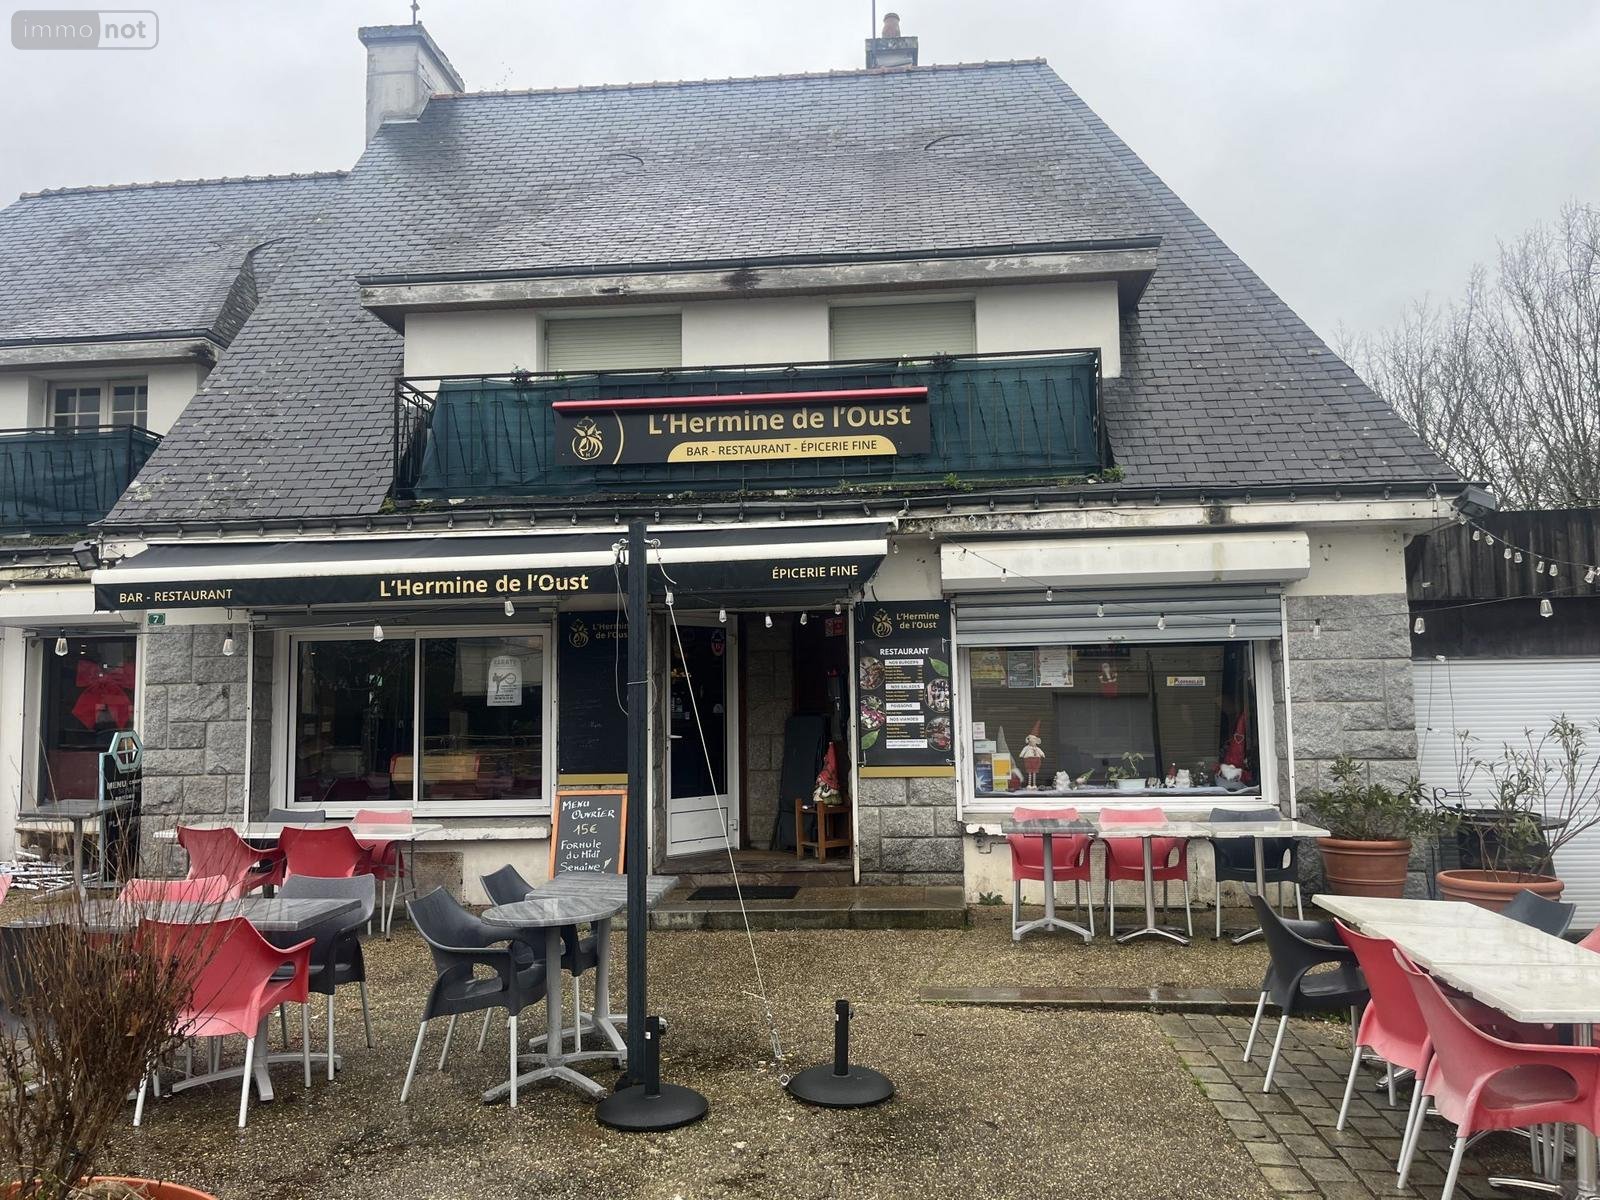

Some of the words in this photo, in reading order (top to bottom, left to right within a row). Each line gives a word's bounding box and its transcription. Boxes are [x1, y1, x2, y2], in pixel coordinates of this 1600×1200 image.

[791, 407, 825, 430] de
[686, 446, 709, 457] BAR
[717, 443, 792, 455] RESTAURANT
[800, 440, 849, 452] ÉPICERIE
[852, 439, 877, 451] FINE
[772, 566, 826, 579] ÉPICERIE
[829, 564, 859, 577] FINE
[380, 576, 488, 597] L'Hermine
[495, 574, 521, 593] de
[526, 573, 589, 592] l'Oust
[119, 591, 143, 603] BAR
[154, 588, 233, 602] RESTAURANT
[152, 614, 160, 624] 7
[896, 611, 940, 620] L'Hermine
[899, 621, 910, 629] de
[595, 631, 607, 639] de
[879, 647, 930, 656] RESTAURANT
[572, 823, 598, 835] 15€
